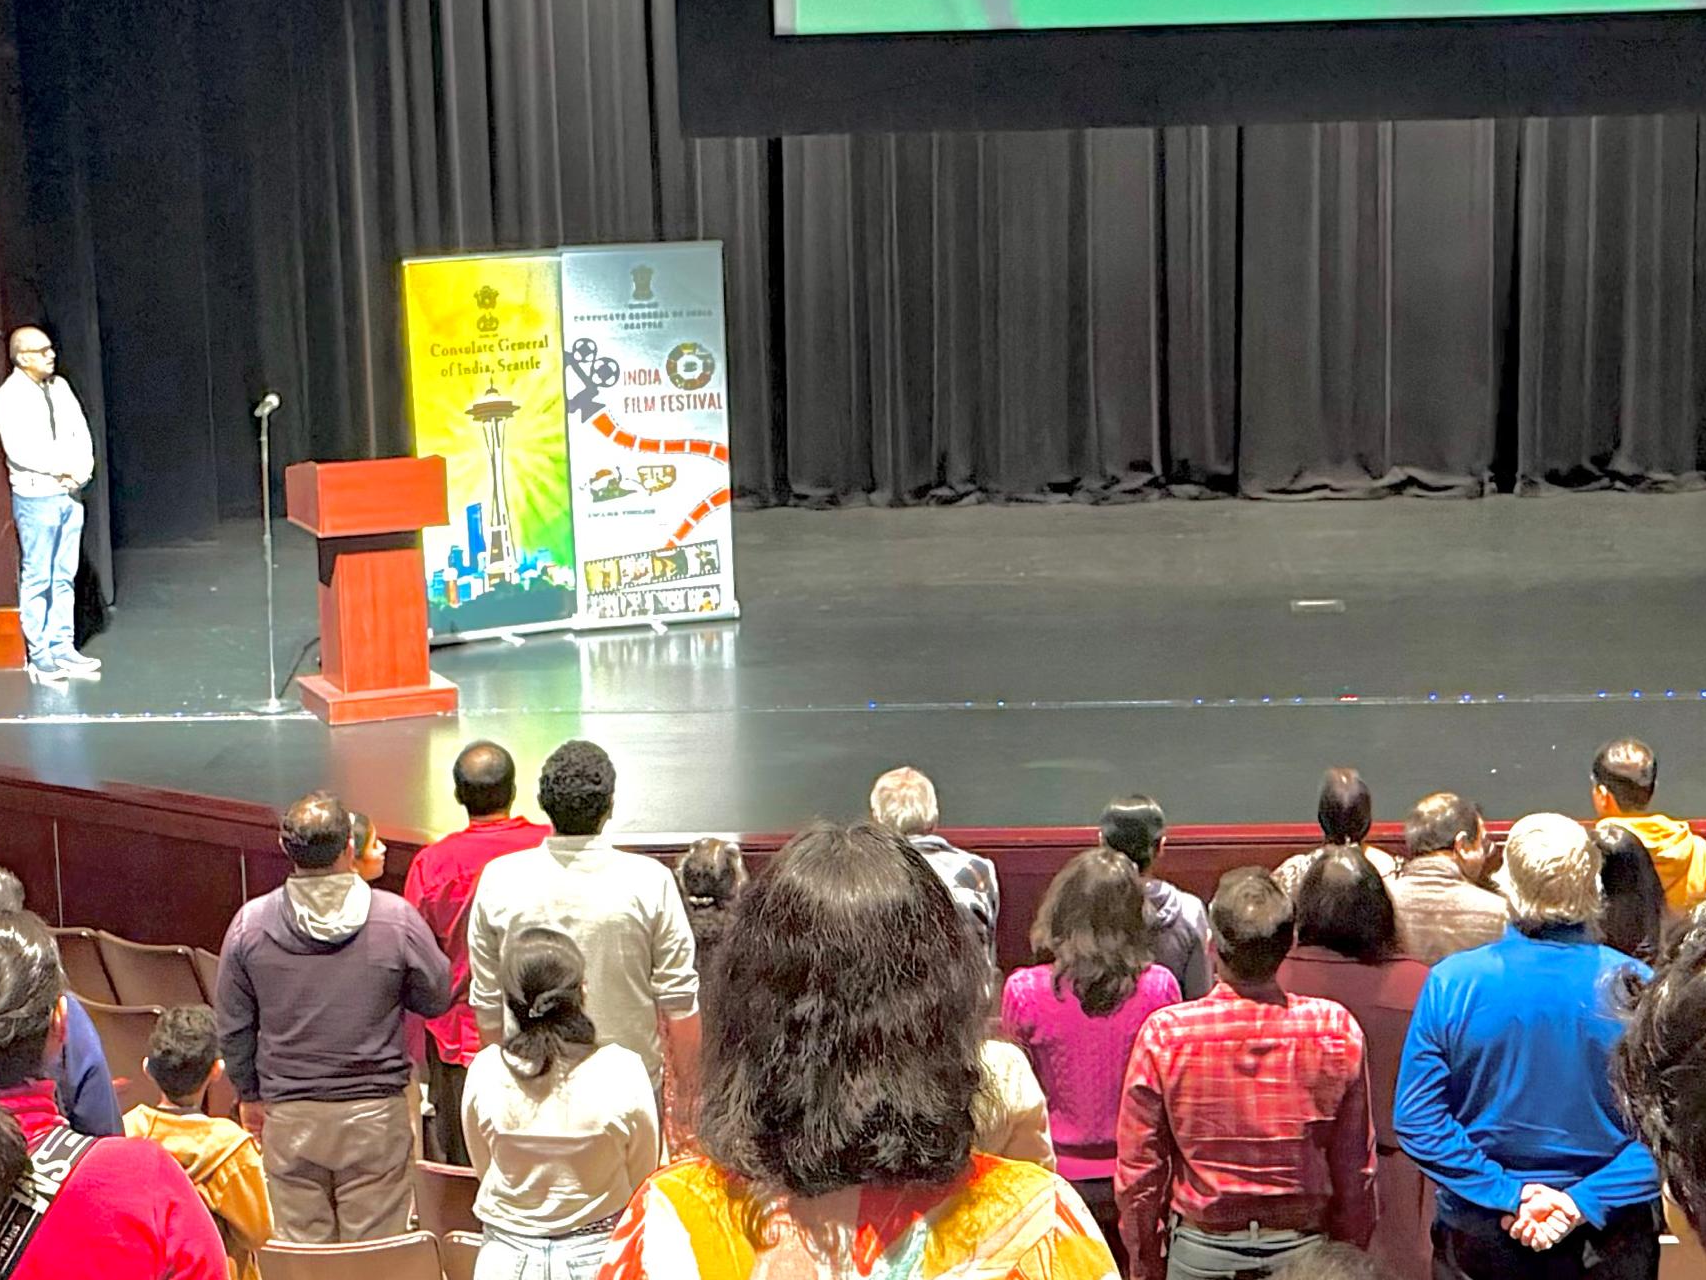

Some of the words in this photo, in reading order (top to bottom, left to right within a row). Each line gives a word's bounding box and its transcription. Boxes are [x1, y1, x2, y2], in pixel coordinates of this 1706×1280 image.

[430, 341, 495, 357] Consulate
[498, 334, 548, 351] General
[441, 362, 455, 377] of
[457, 360, 495, 376] India,
[497, 356, 541, 372] Seattle
[623, 368, 662, 386] INDIA
[624, 396, 656, 413] FILM
[660, 392, 723, 412] FESTIVAL
